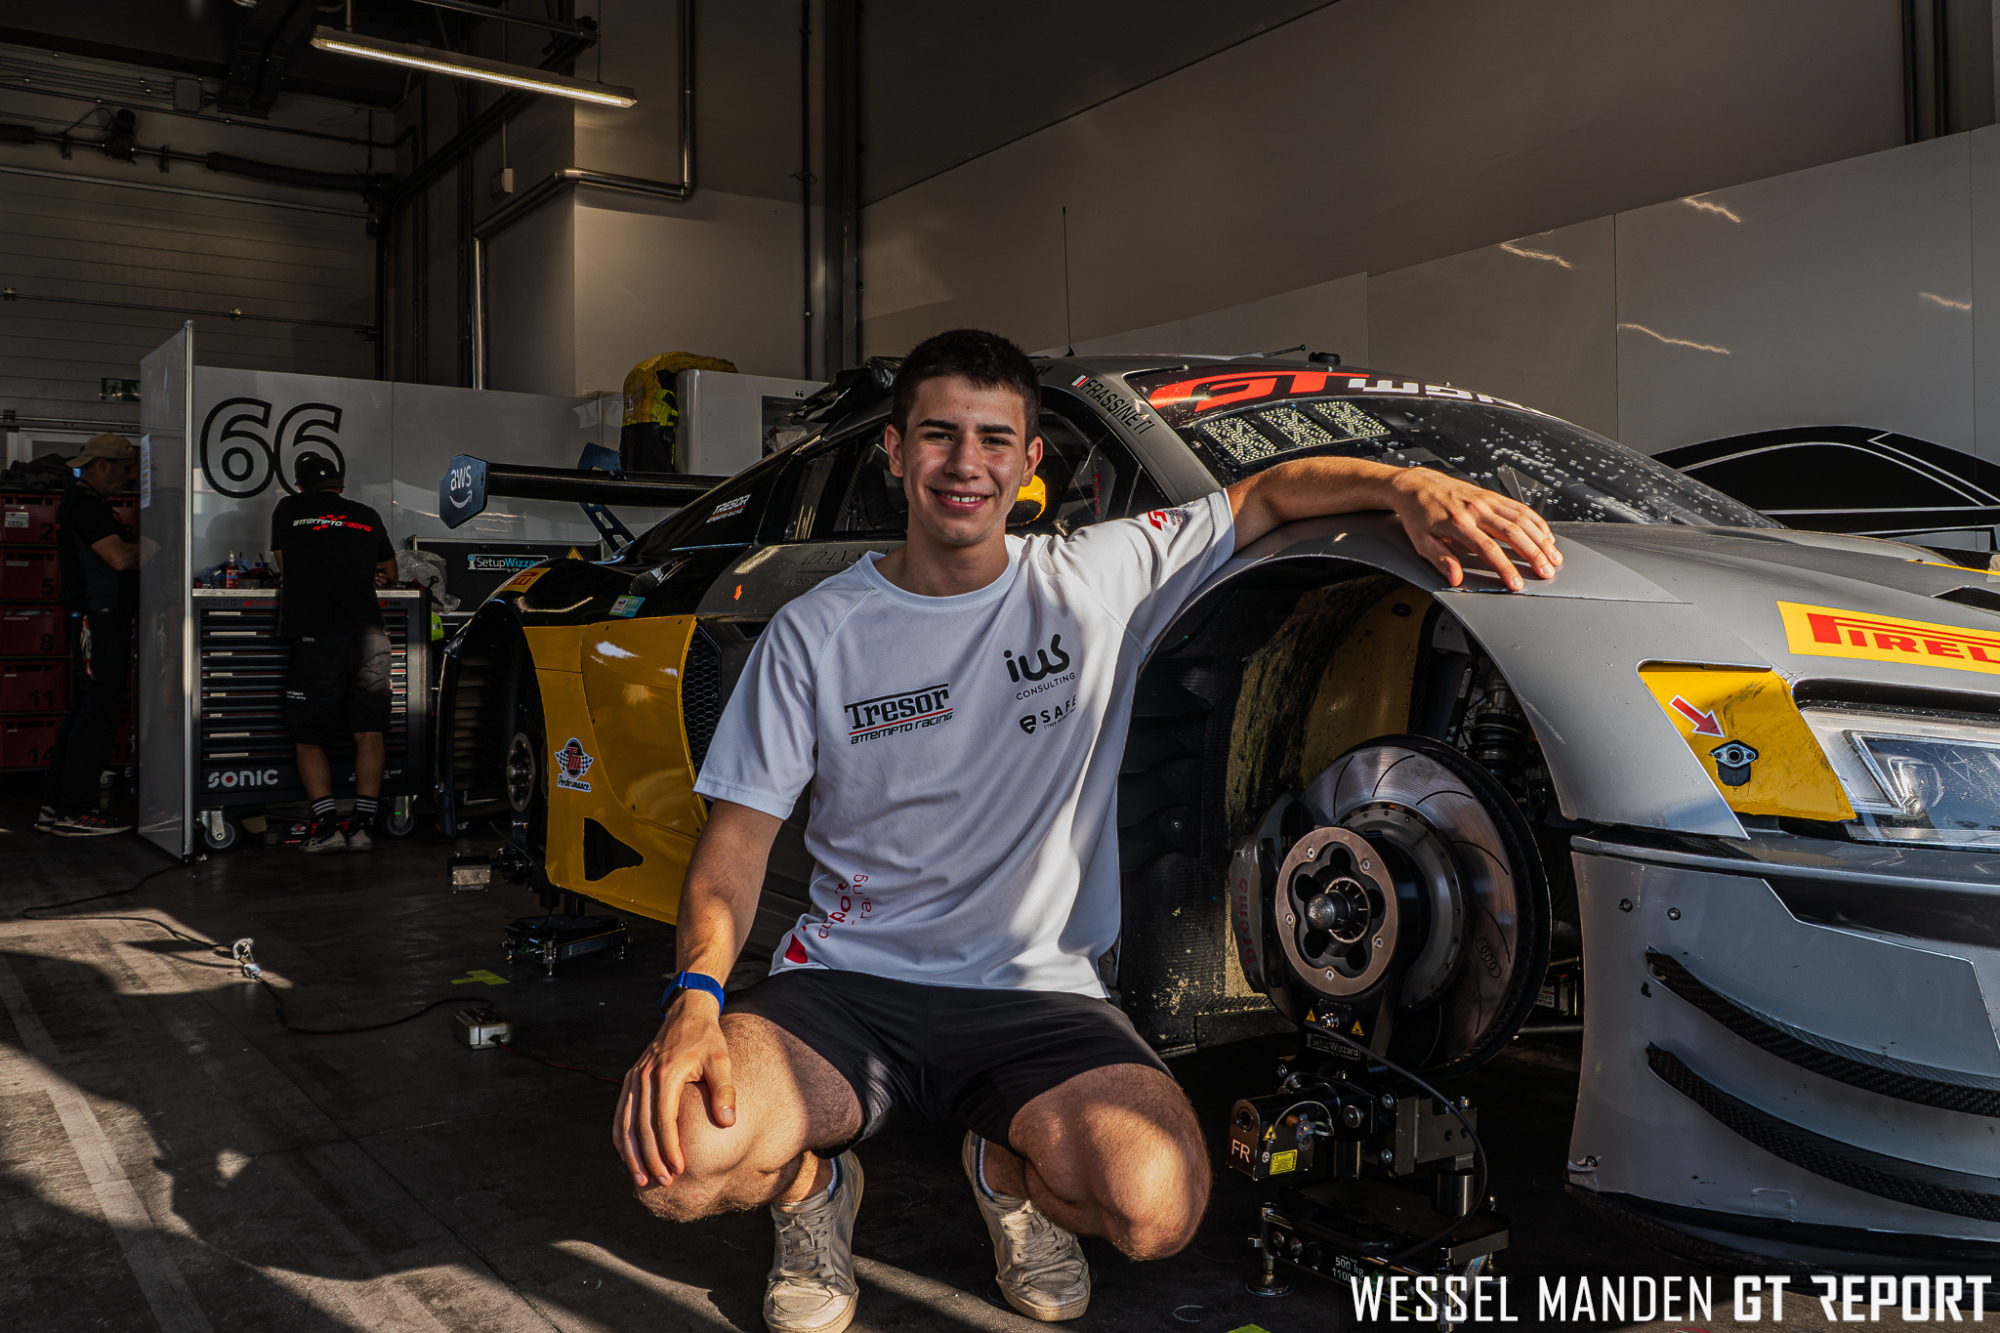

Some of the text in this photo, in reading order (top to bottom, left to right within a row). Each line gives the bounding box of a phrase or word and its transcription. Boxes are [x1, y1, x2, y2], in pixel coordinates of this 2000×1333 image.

[200, 397, 346, 499] 66
[450, 465, 472, 492] aws
[41, 522, 54, 541] 2
[476, 556, 547, 570] SetupWizza
[41, 578, 55, 596] 5
[40, 633, 53, 652] 8
[1003, 633, 1070, 683] ius
[1016, 672, 1076, 700] CONSULTING
[29, 689, 54, 708] 11
[844, 683, 950, 730] Tresor
[1231, 1138, 1251, 1163] FR
[1335, 1256, 1351, 1271] 500
[1353, 1263, 1366, 1279] kg
